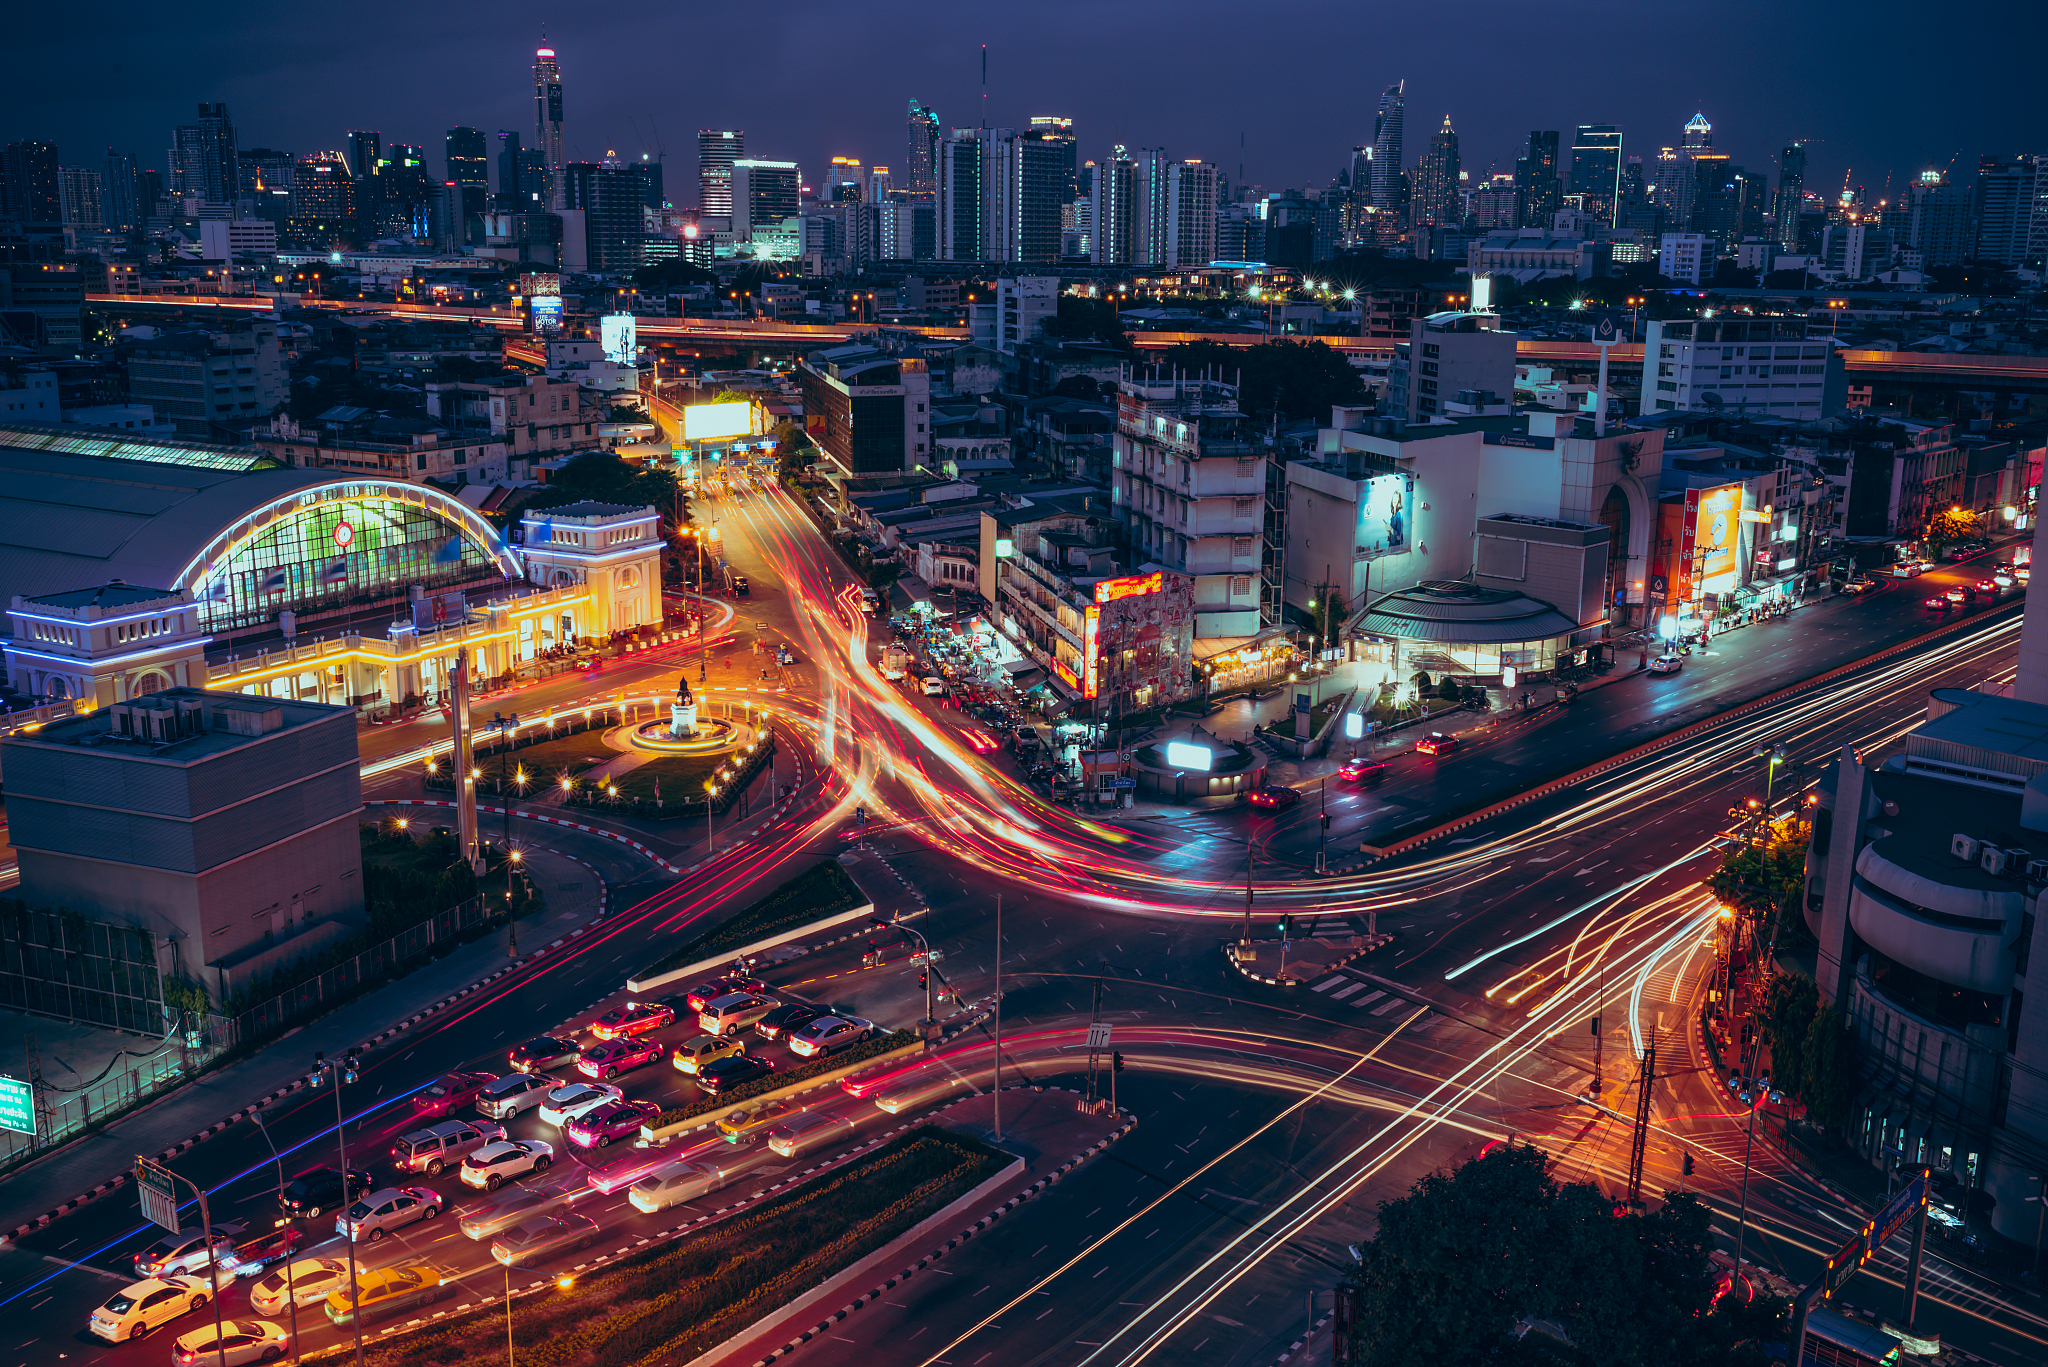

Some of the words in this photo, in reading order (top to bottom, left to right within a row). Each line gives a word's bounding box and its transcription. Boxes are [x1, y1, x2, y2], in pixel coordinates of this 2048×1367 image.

[1119, 410, 1135, 423] HOTEL
[1686, 500, 1698, 513] โรง
[1740, 512, 1770, 522] โจำนำ
[1685, 526, 1694, 537] รับ
[1682, 550, 1692, 560] จำ
[1680, 573, 1691, 584] นำ
